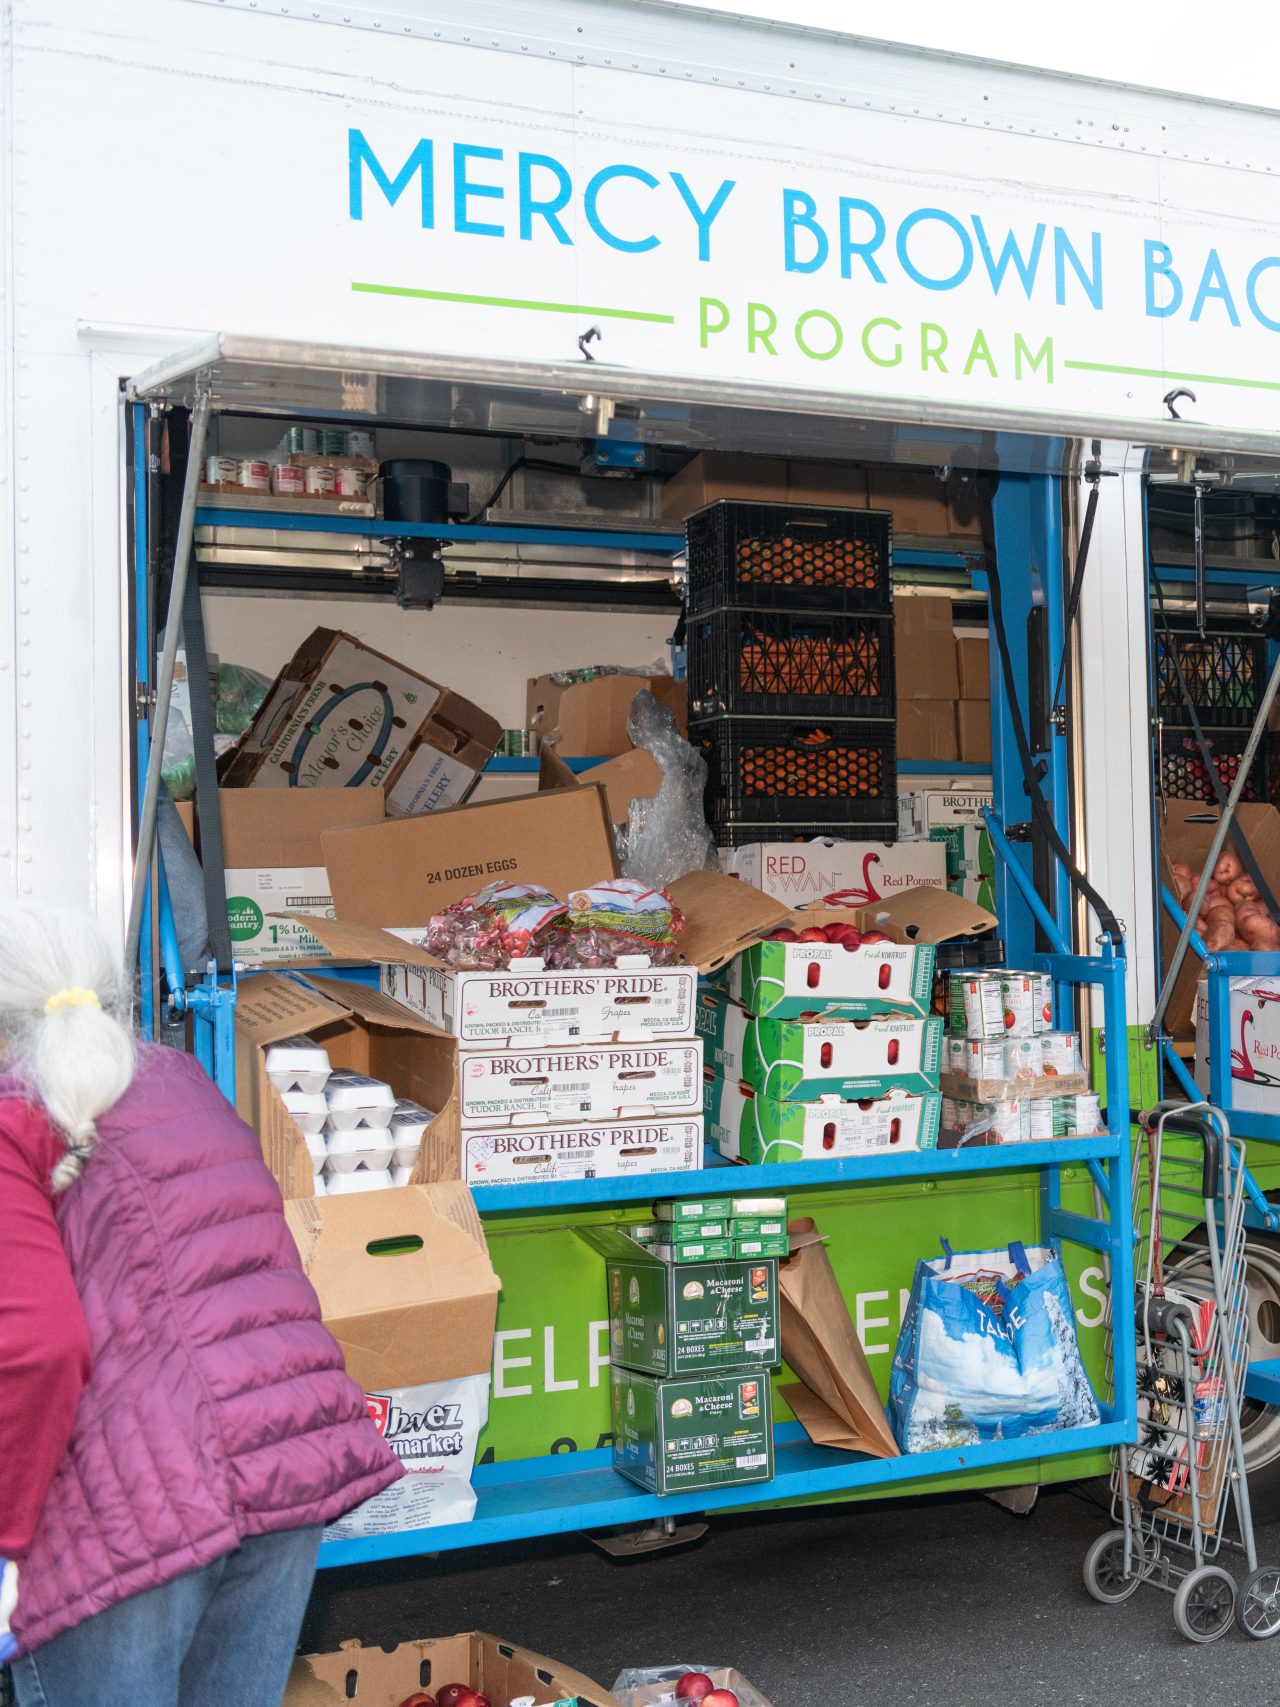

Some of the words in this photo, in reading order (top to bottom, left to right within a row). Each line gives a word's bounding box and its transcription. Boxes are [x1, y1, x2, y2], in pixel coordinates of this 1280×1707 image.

[348, 129, 736, 262] MERCY
[782, 188, 1103, 310] BROWN
[699, 297, 1054, 385] PROGRAM
[305, 681, 327, 710] FRESH
[346, 705, 384, 753] Choice
[370, 747, 399, 787] CELERY
[421, 773, 451, 810] ELERY
[943, 797, 994, 808] BROTHE
[427, 872, 441, 884] 24
[445, 864, 484, 881] DOZEN
[486, 858, 518, 874] EGGS
[766, 856, 806, 874] RED
[767, 871, 836, 893] SWAN
[883, 874, 903, 887] Red
[905, 874, 942, 887] Potatoes
[229, 921, 259, 930] antry
[792, 948, 832, 960] PROPAL
[864, 950, 881, 959] Fresh
[881, 951, 907, 959] KIWIFRUIT
[489, 979, 600, 998] BROTHERS'
[604, 977, 664, 994] PRIDE
[469, 1028, 499, 1036] TUDOR
[808, 1026, 845, 1037] PROPAL
[874, 1024, 890, 1033] Fresh
[889, 1024, 915, 1033] KIWIFRUIT
[1253, 1039, 1269, 1056] Red
[490, 1054, 604, 1075] BROTHERS'
[608, 1052, 668, 1069] PRIDE
[613, 1081, 636, 1094] rapes
[470, 1104, 501, 1113] TUDOR
[493, 1131, 606, 1154] BROTHERS'
[610, 1127, 670, 1146] PRIDE
[617, 1160, 638, 1171] rapes
[706, 1276, 744, 1287] Macaroni
[677, 1346, 685, 1355] 24
[686, 1344, 705, 1354] BOXES
[494, 1321, 609, 1398] ELP
[695, 1392, 734, 1404] Macaroni
[666, 1465, 674, 1473] 24
[675, 1463, 695, 1472] BOXES
